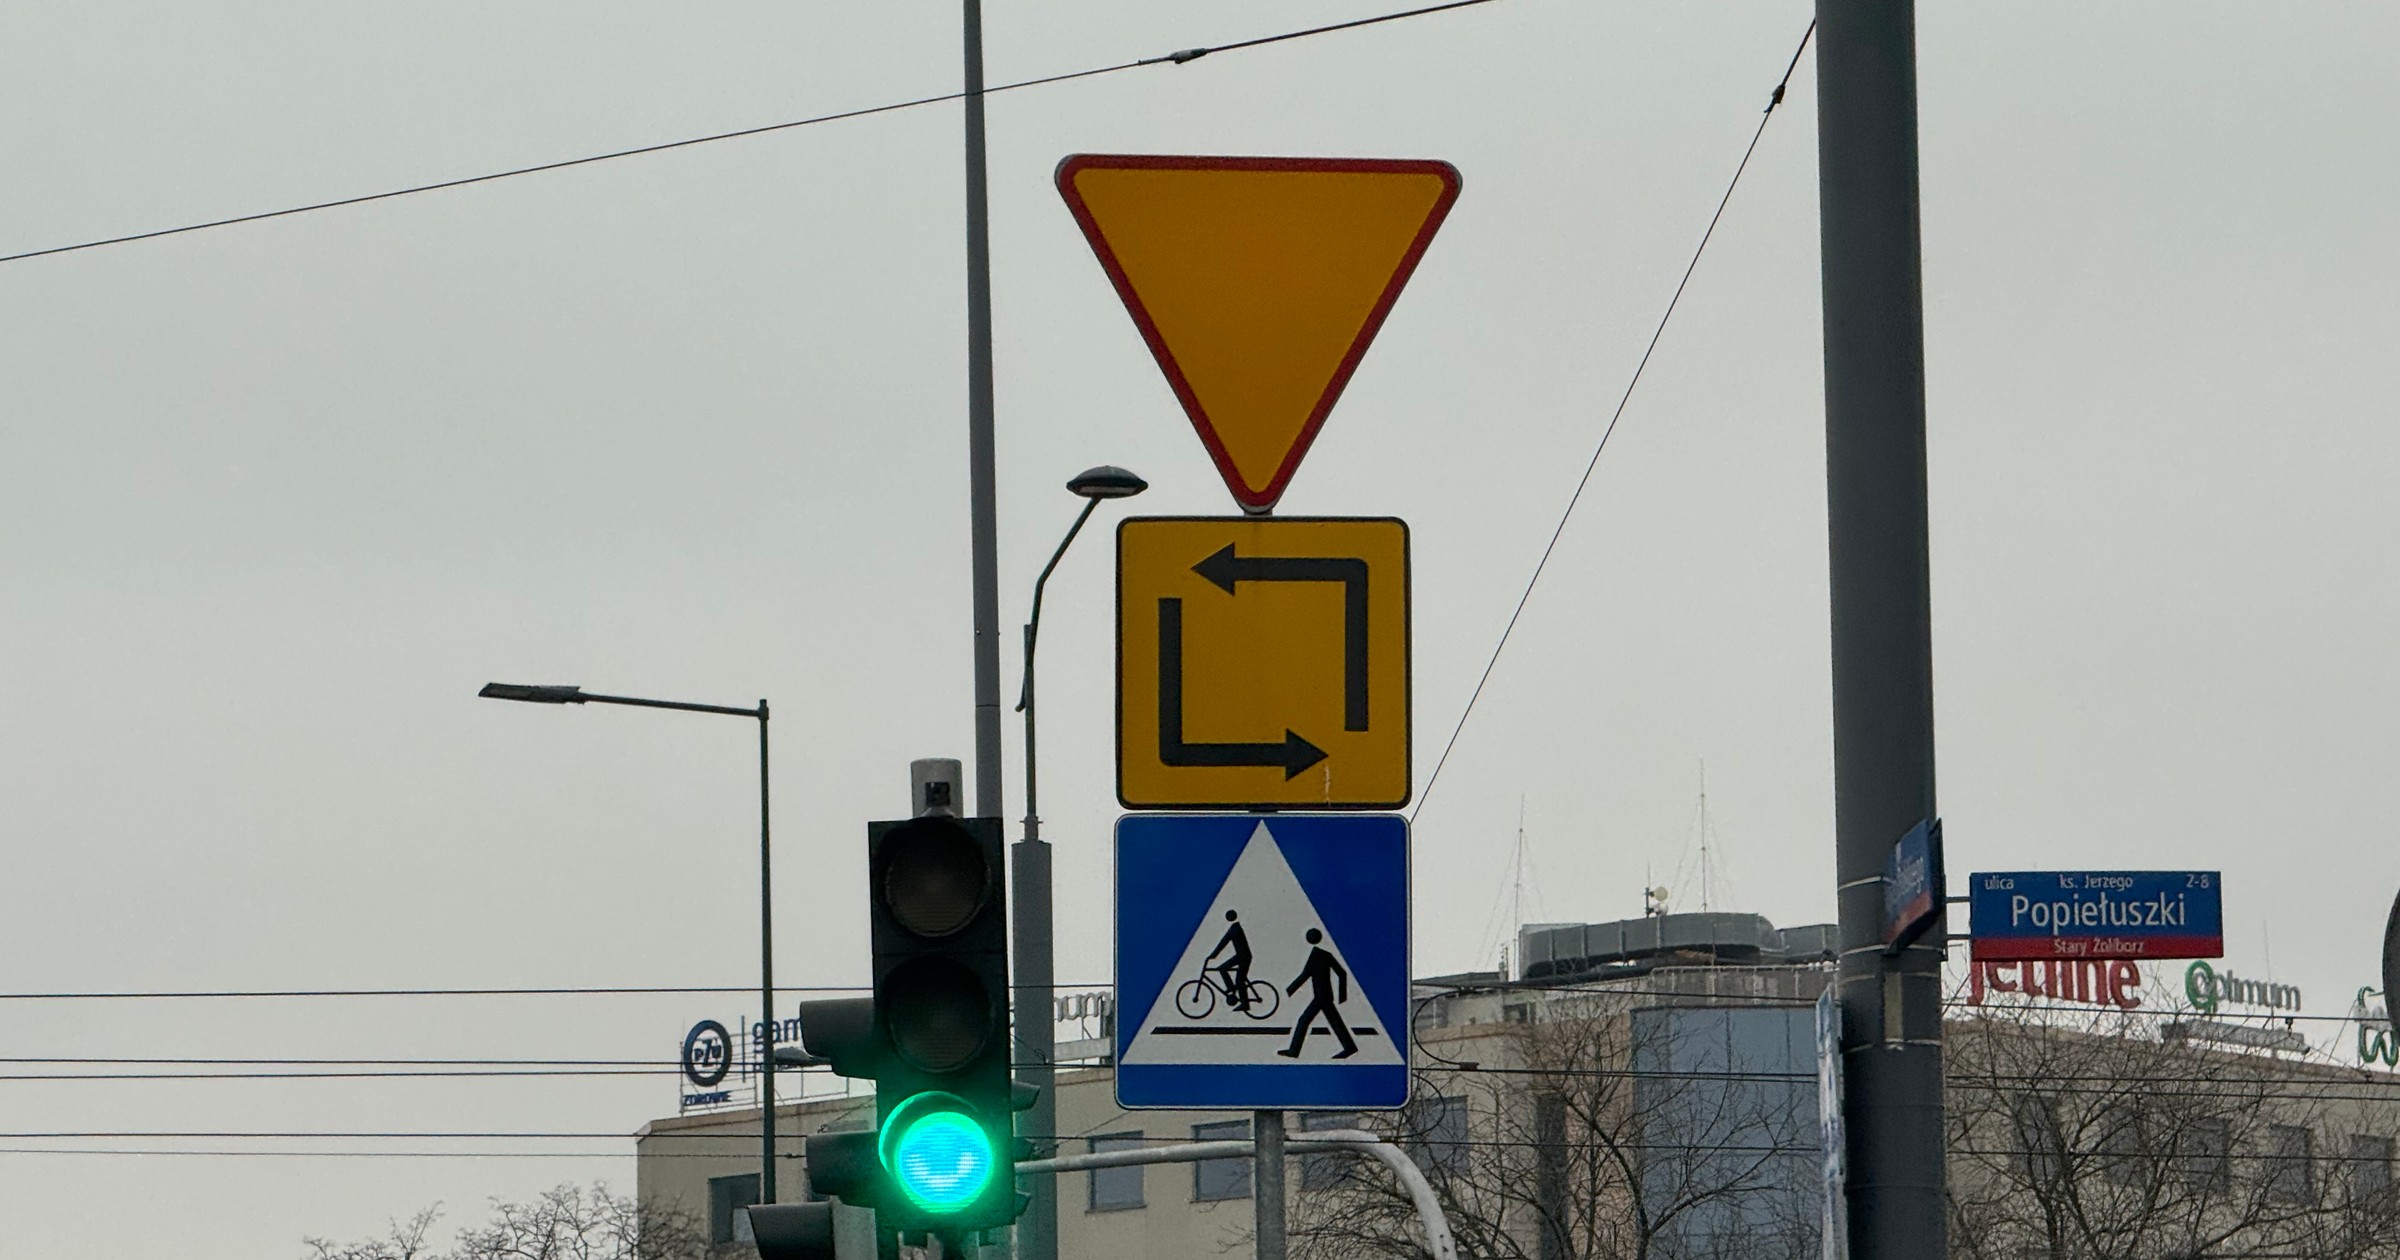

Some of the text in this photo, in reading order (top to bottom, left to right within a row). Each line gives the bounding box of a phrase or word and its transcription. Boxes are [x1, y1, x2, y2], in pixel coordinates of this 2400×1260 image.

[1984, 873, 2210, 891] ulica ks. Jerzego 2-8
[2011, 891, 2185, 935] Popiełuszki
[2053, 938, 2088, 957] Stary
